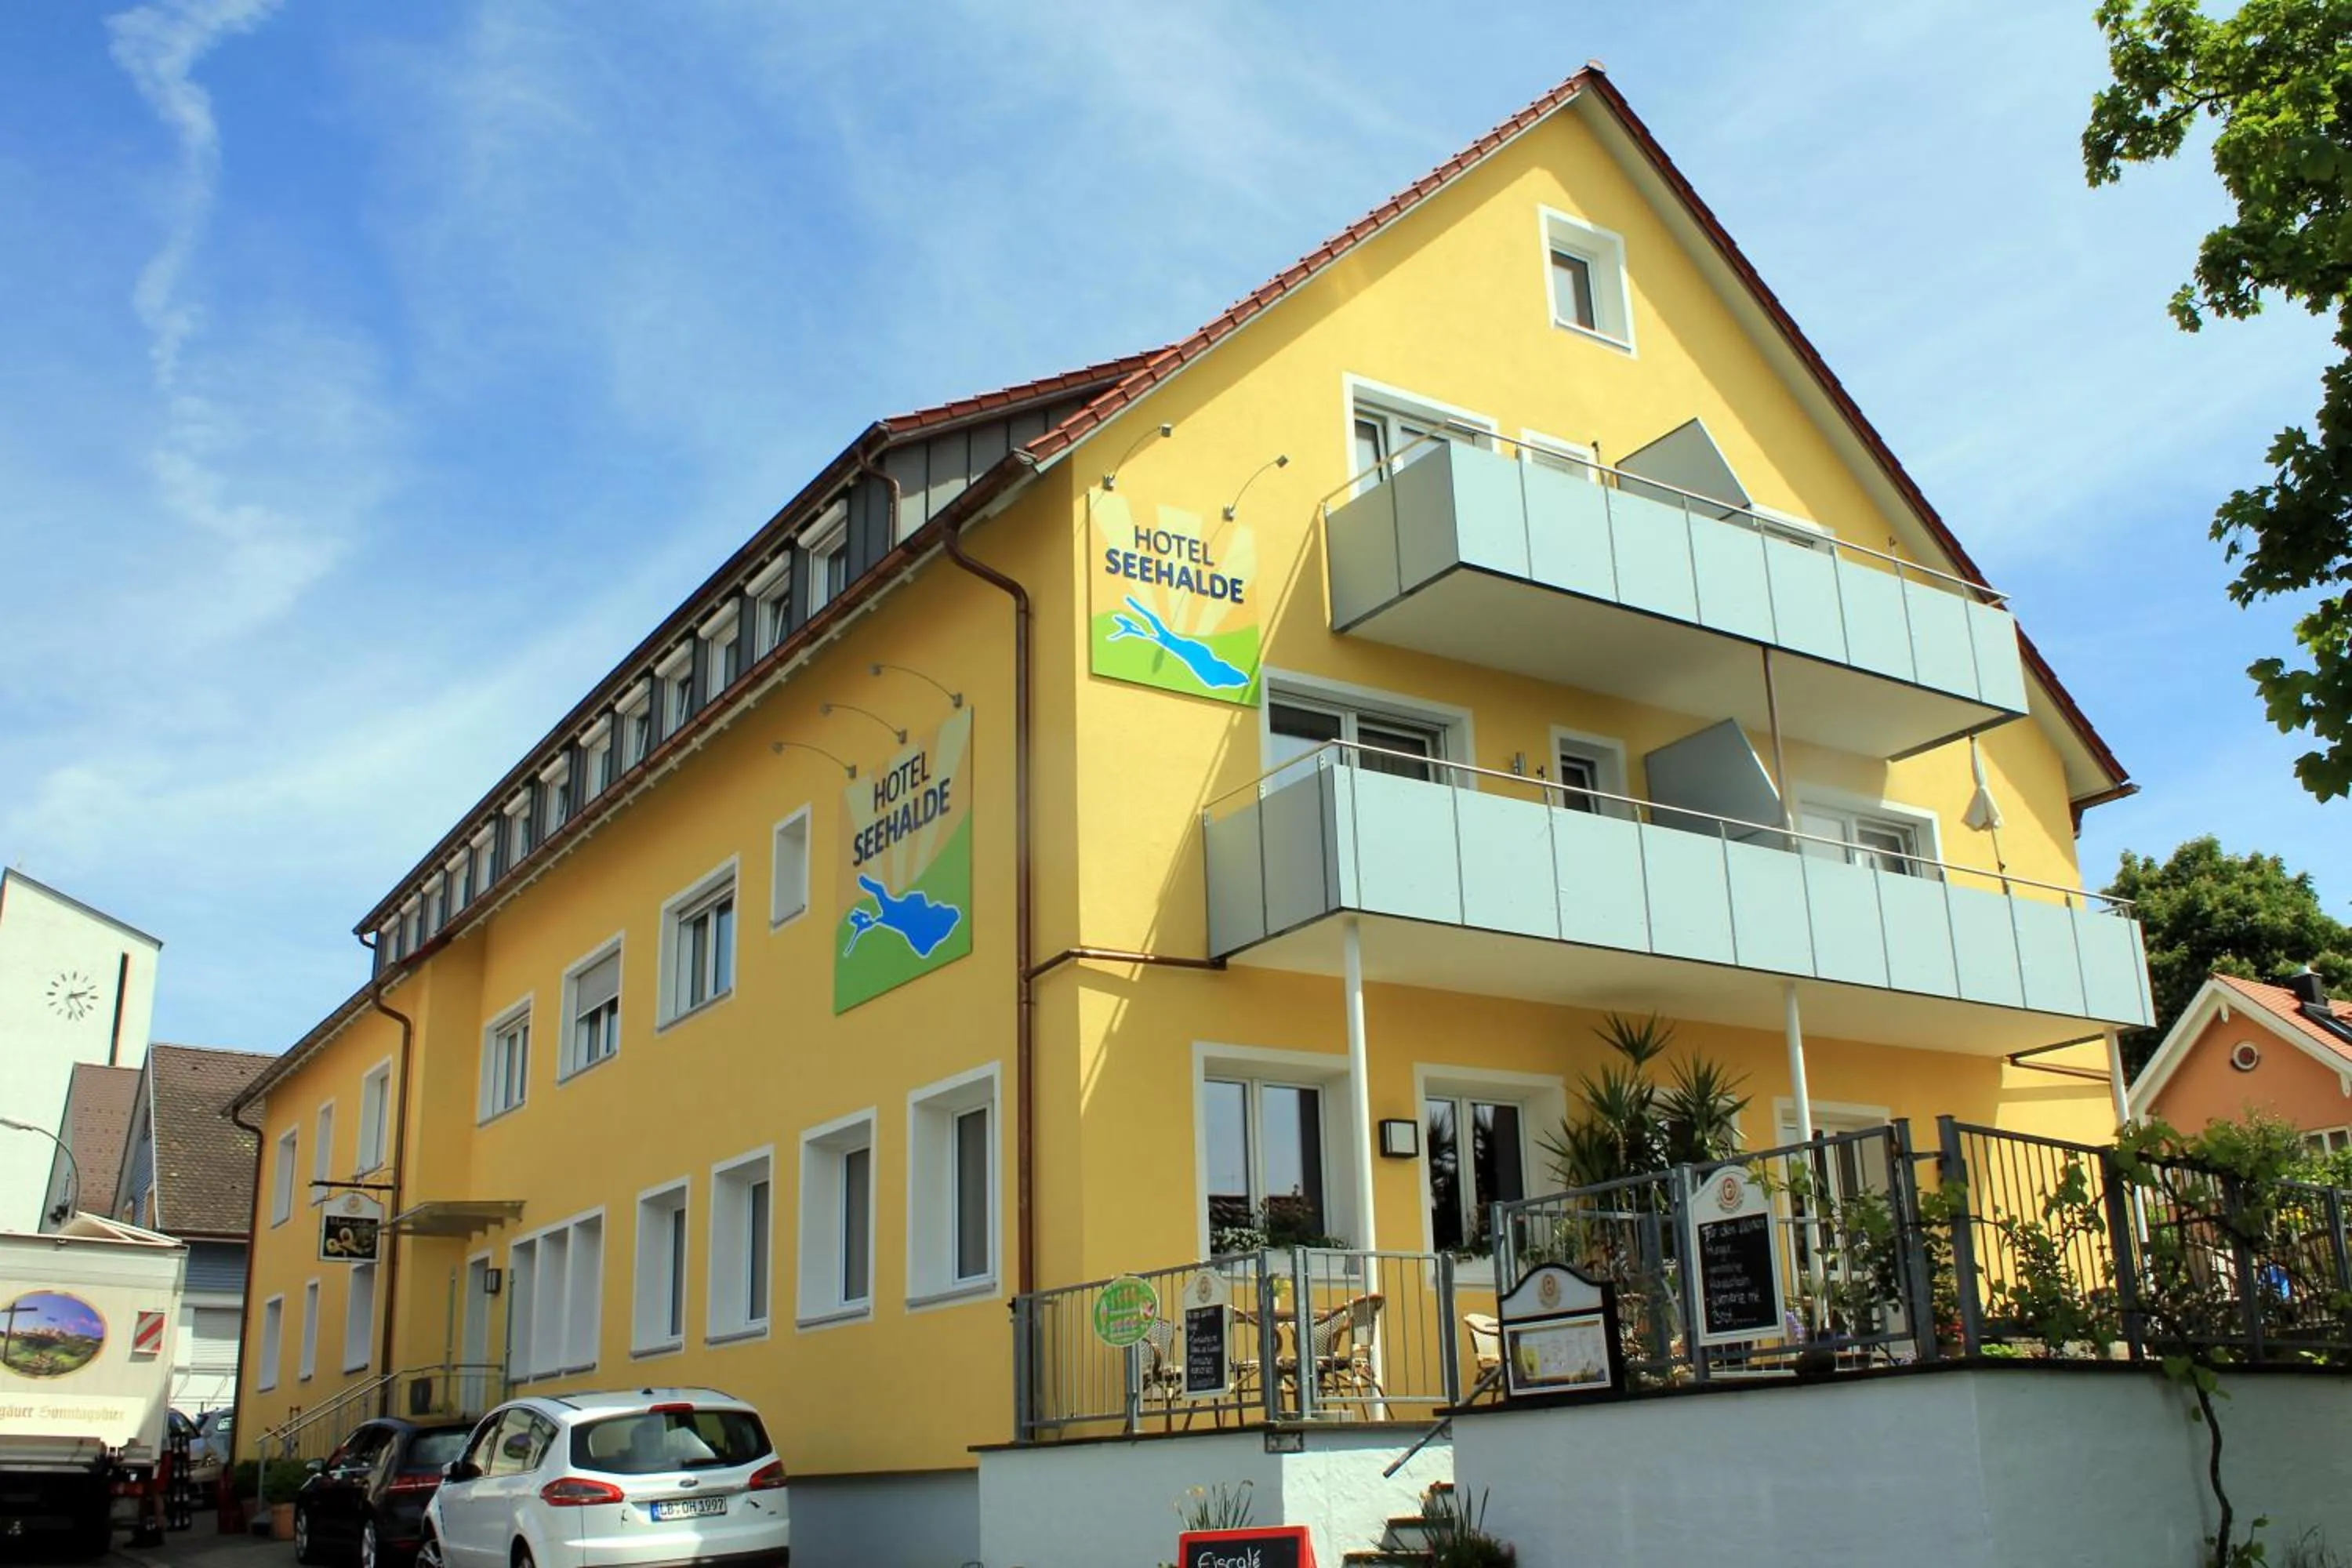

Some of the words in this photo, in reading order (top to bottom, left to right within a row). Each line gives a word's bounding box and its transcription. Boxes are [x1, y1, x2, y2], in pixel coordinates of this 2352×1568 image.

[1134, 524, 1214, 567] HOTEL
[1105, 548, 1244, 604] SEEHALDE
[873, 750, 931, 813] HOTEL
[852, 778, 951, 867] SEEHALDE
